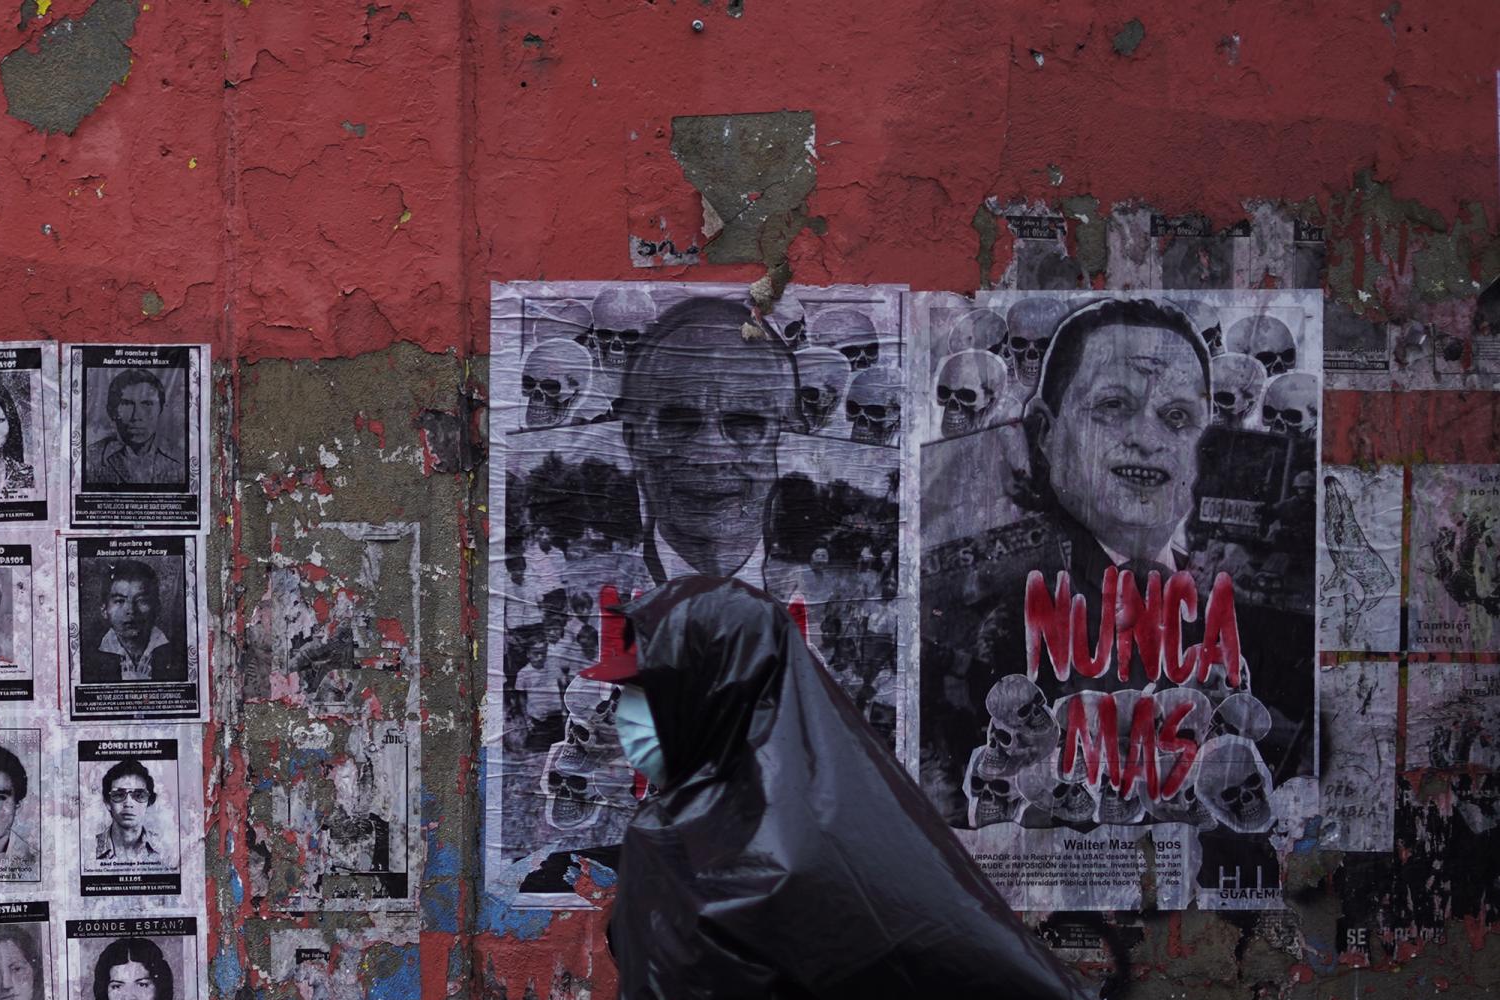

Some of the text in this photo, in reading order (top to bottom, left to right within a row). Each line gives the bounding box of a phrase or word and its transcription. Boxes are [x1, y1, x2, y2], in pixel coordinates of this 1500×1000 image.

[1024, 566, 1241, 687] NUNCA
[1416, 635, 1462, 644] existen
[1063, 840, 1105, 849] Walter
[77, 918, 184, 932] ¿DÓNDE ESTÁN?
[1346, 928, 1366, 945] SE
